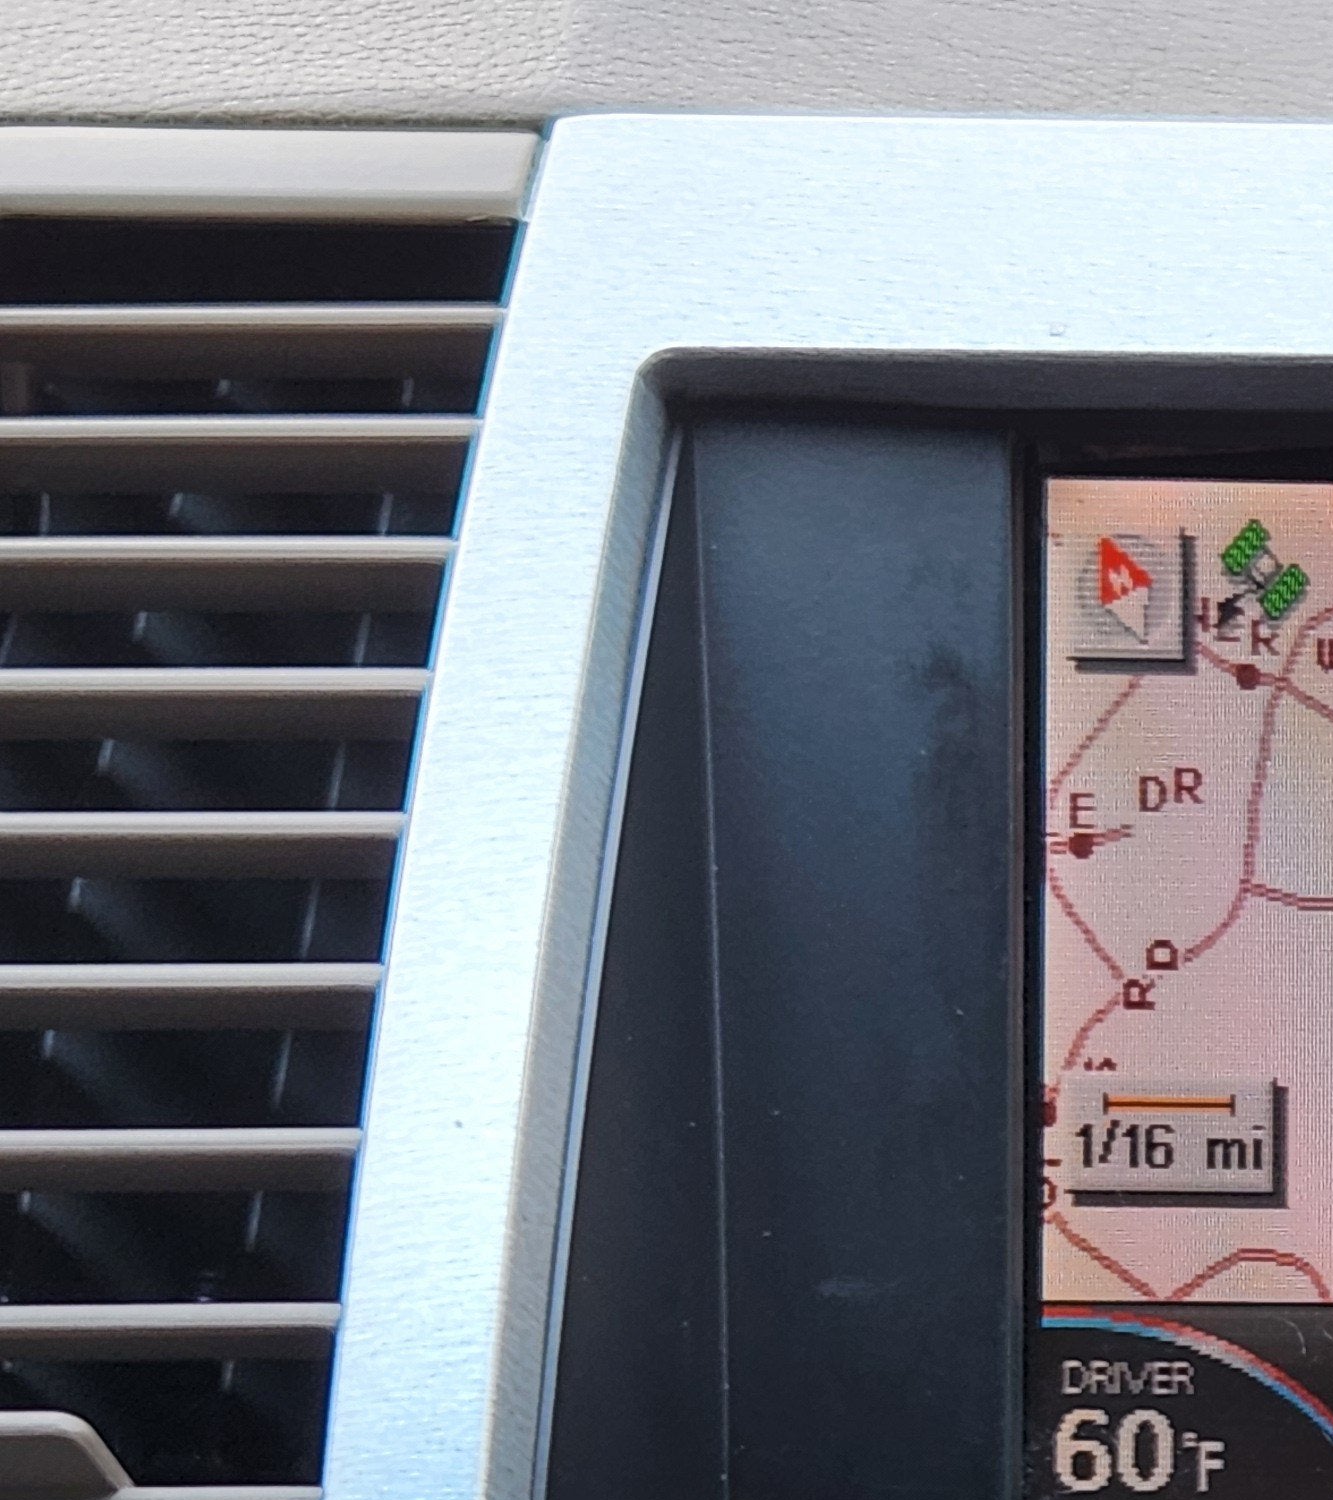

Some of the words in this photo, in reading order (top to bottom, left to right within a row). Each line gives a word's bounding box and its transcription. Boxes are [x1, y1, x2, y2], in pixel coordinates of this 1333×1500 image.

[1139, 767, 1202, 813] DR
[1075, 1119, 1174, 1169] 1/16
[1206, 1125, 1263, 1170] mi
[1062, 1361, 1195, 1394] DRIVER
